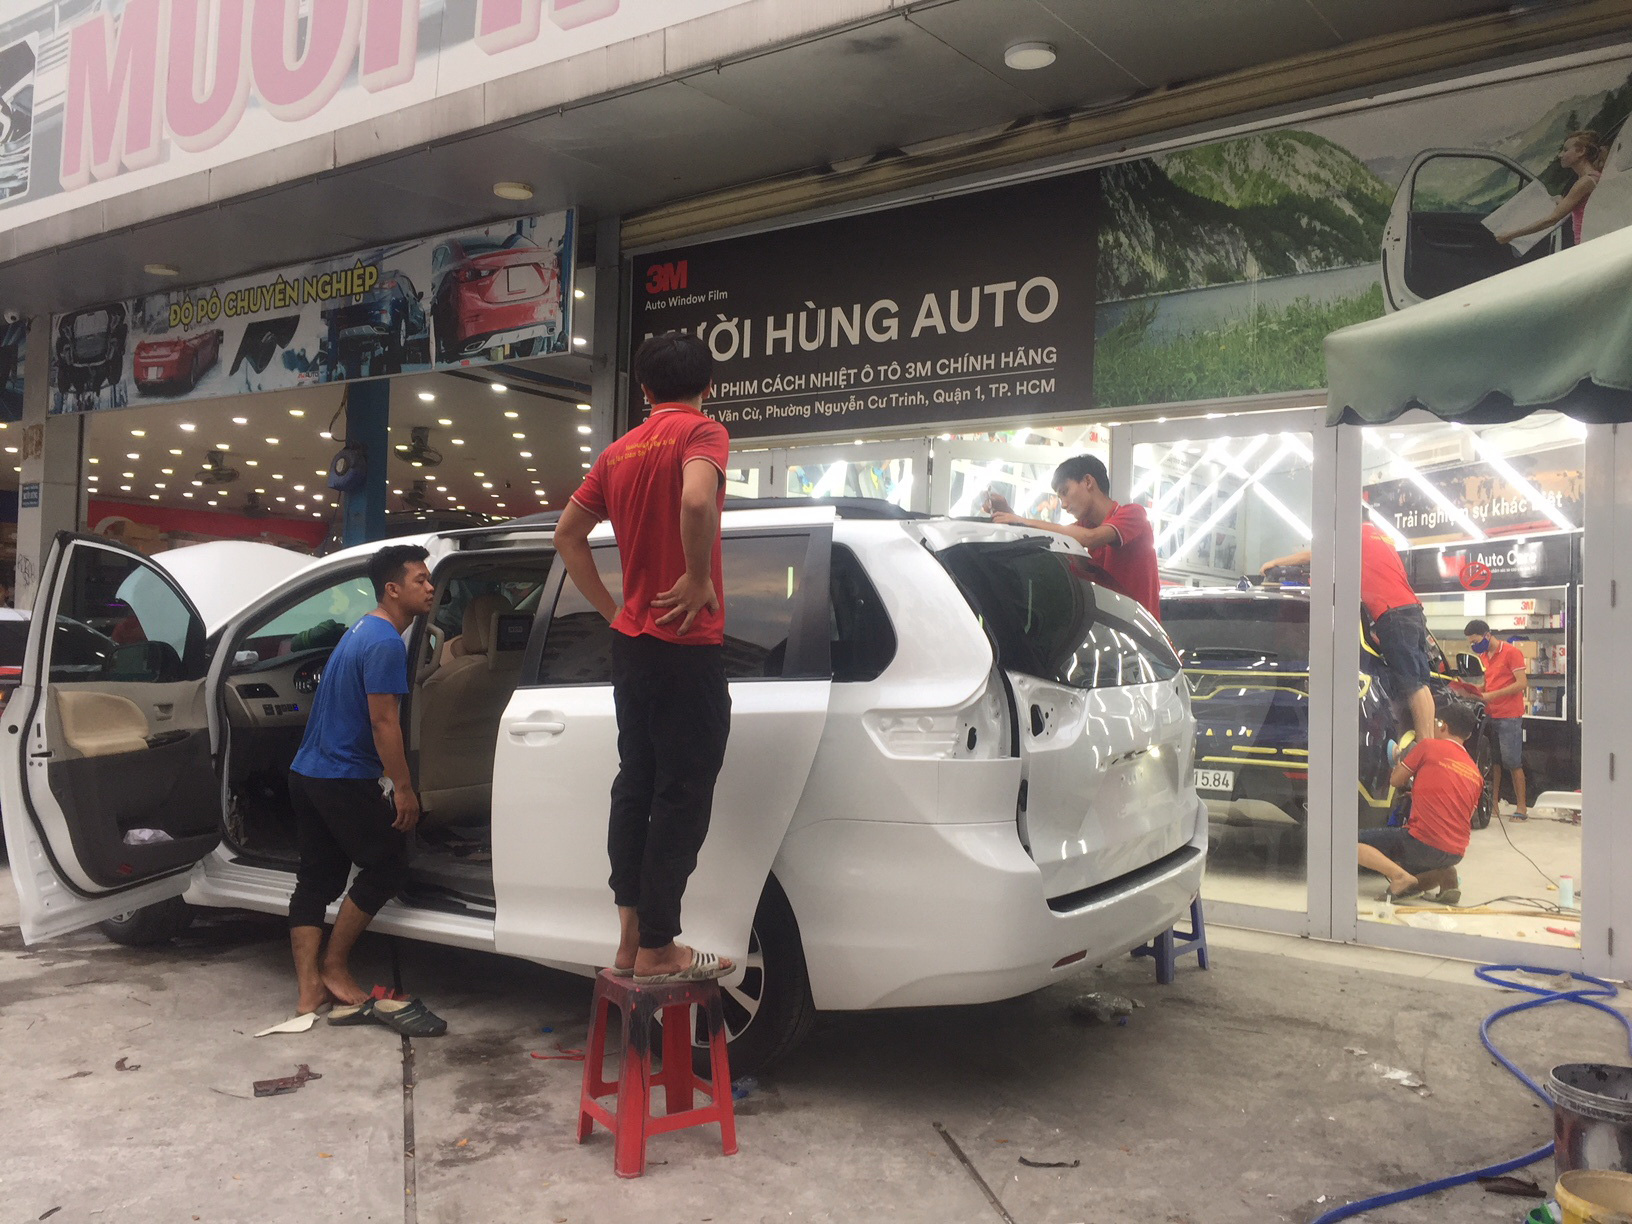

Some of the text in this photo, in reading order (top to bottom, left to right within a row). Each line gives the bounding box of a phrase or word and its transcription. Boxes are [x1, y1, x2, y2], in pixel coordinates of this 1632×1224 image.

[646, 260, 688, 294] 3M
[169, 257, 378, 332] ĐỘ PÔ CHUYÊN NGHIỆP
[645, 290, 728, 311] Auto Window Film
[644, 276, 1058, 362] ỜI HÙNG AUTO
[721, 380, 758, 398] PHIM
[762, 374, 806, 393] CÁCH
[810, 367, 857, 388] NHIỆT
[861, 364, 874, 383] Ô
[877, 361, 901, 381] TÔ
[905, 360, 931, 378] 3M
[936, 353, 995, 375] CHÍNH
[1001, 346, 1057, 369] HÃNG
[718, 409, 739, 422] Văn
[742, 407, 763, 421] Cừ,
[766, 404, 811, 420] Phường
[815, 394, 864, 415] Nguyễn
[867, 395, 888, 409] Cư
[889, 391, 930, 407] Trinh,
[933, 388, 970, 404] Quận
[975, 385, 985, 401] 1,
[989, 383, 1012, 398] TP.
[1016, 378, 1056, 395] HCM
[1394, 510, 1418, 528] Trải
[1421, 504, 1469, 528] nghim
[1473, 503, 1489, 522] sự
[1493, 496, 1527, 517] khác
[1477, 552, 1504, 567] Auto
[1514, 616, 1526, 626] 3M
[1521, 601, 1534, 611] 3M
